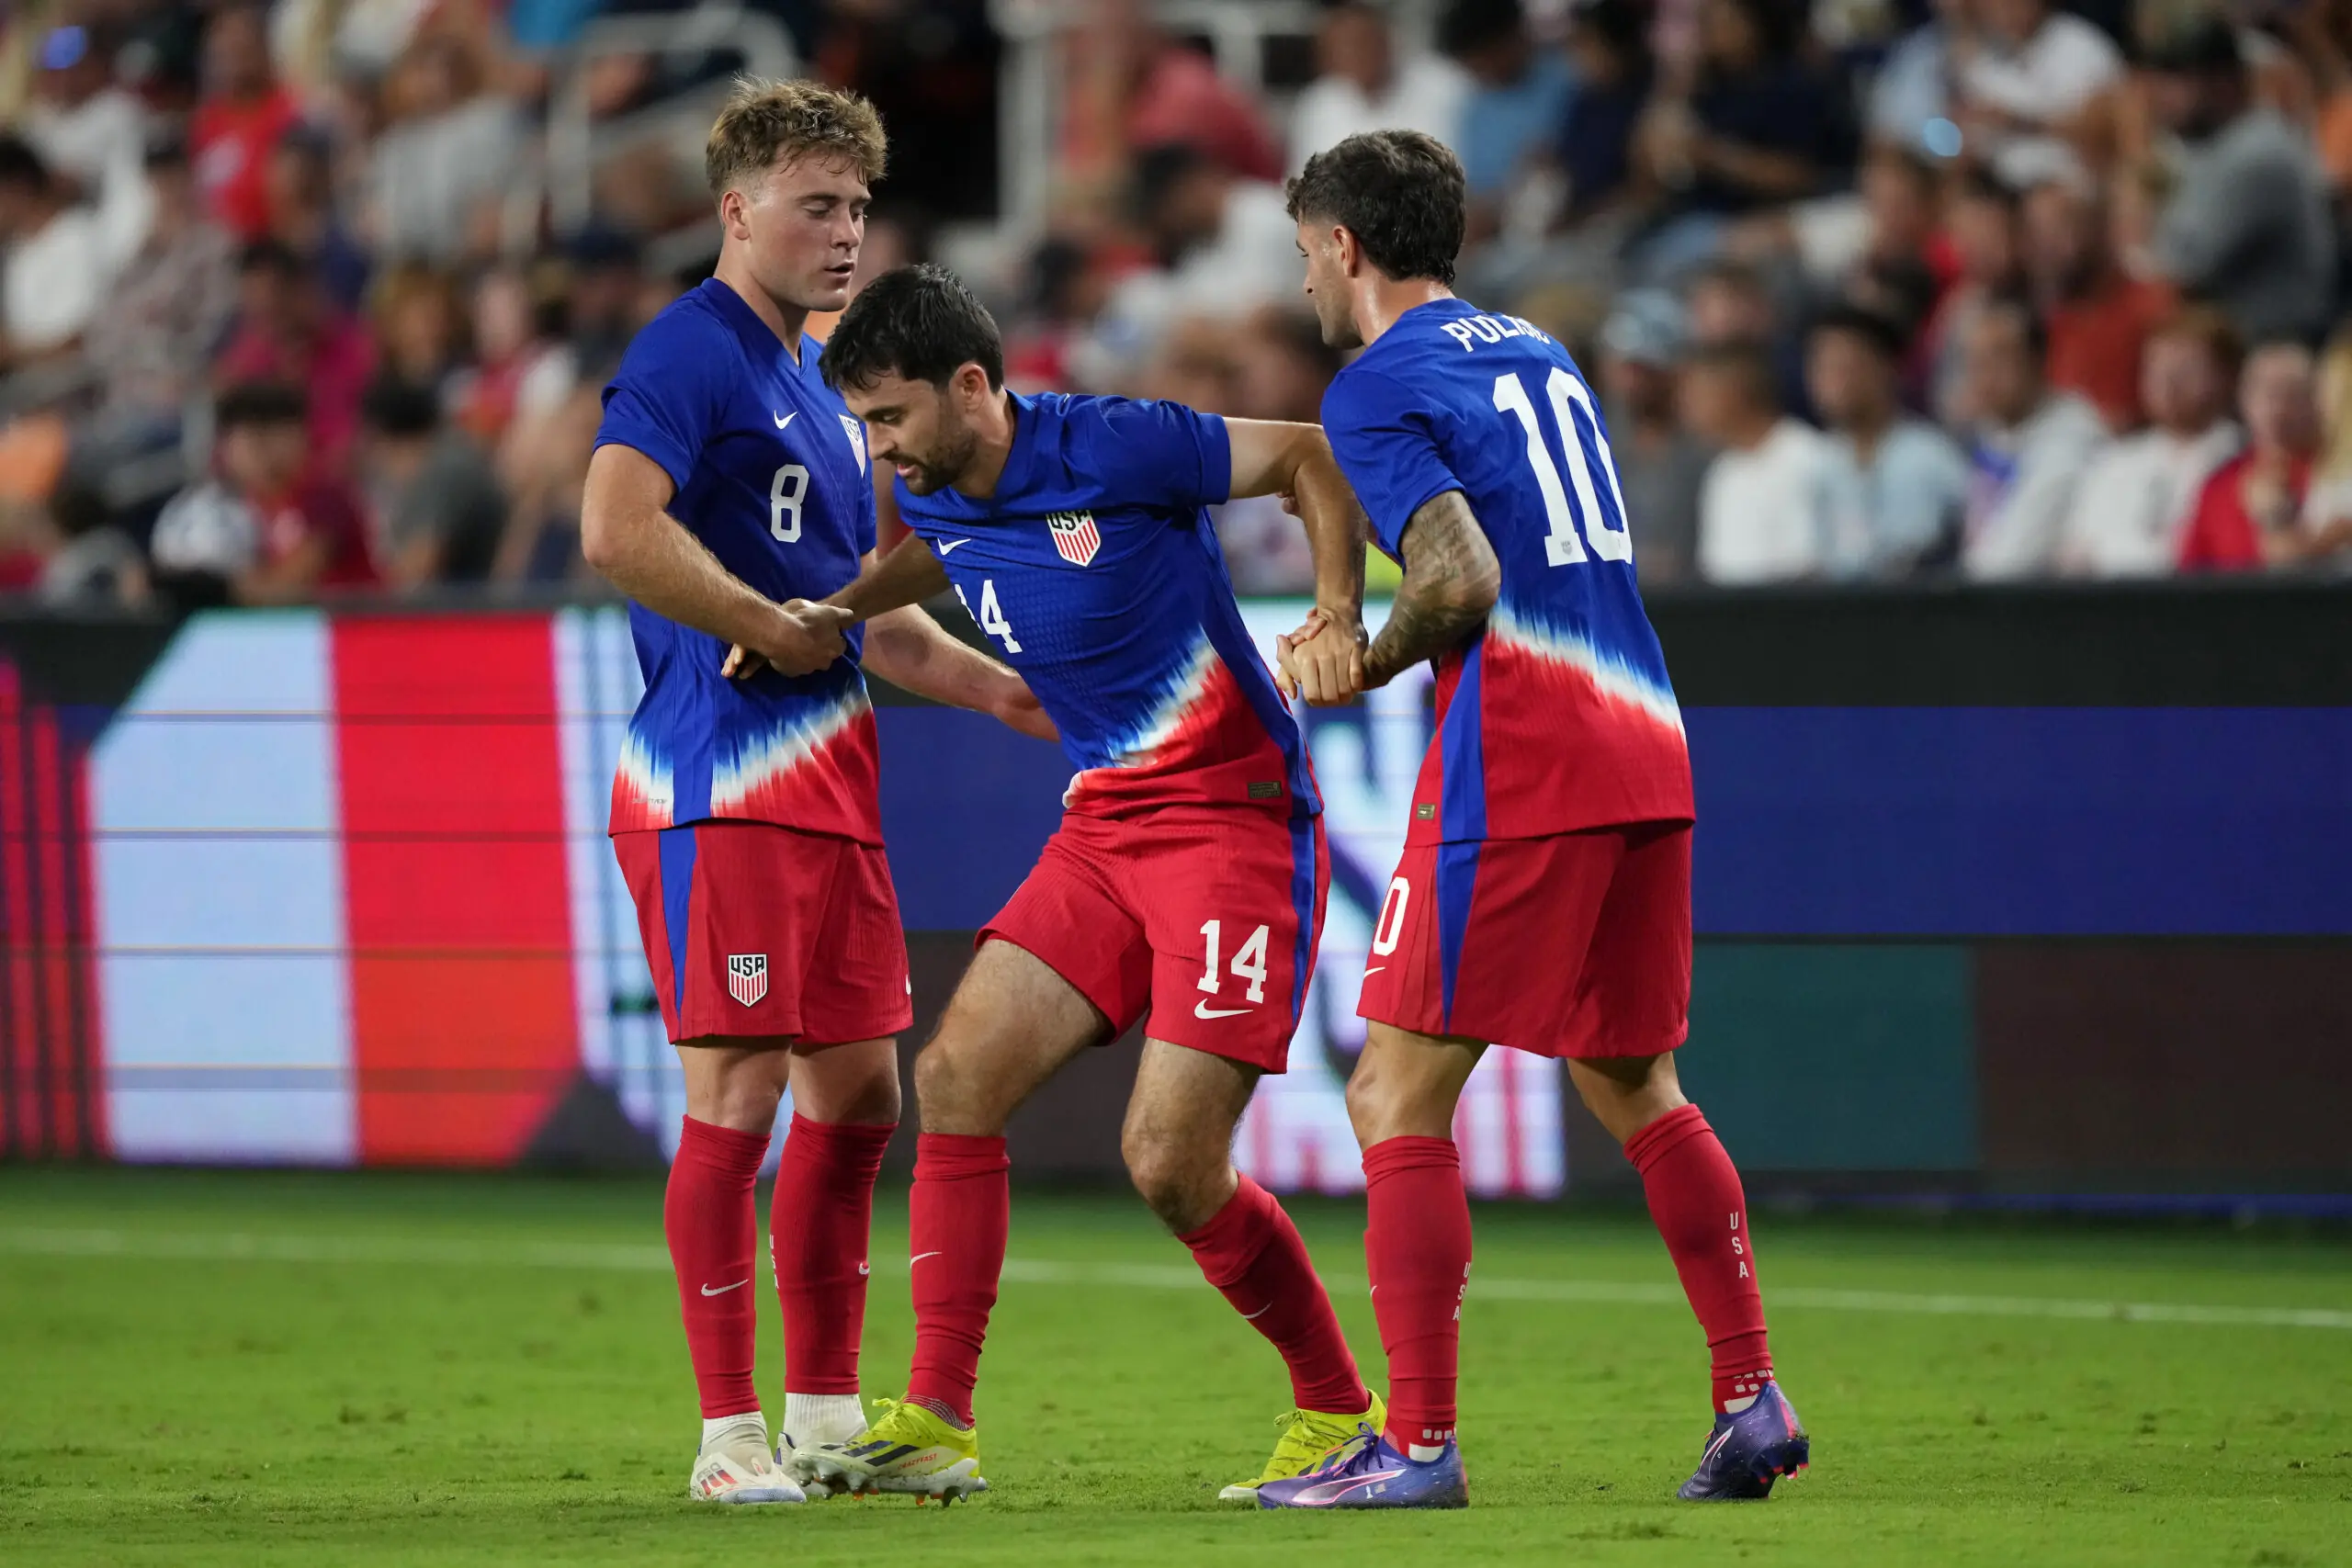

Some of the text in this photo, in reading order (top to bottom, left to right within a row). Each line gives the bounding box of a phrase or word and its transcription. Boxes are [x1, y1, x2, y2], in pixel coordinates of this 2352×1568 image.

[770, 463, 810, 543] 8
[1492, 367, 1633, 565] 10
[1373, 875, 1410, 956] 0
[730, 956, 764, 977] USA
[1196, 919, 1269, 1003] 14
[1730, 1211, 1749, 1279] USA
[1453, 1261, 1471, 1321] USA
